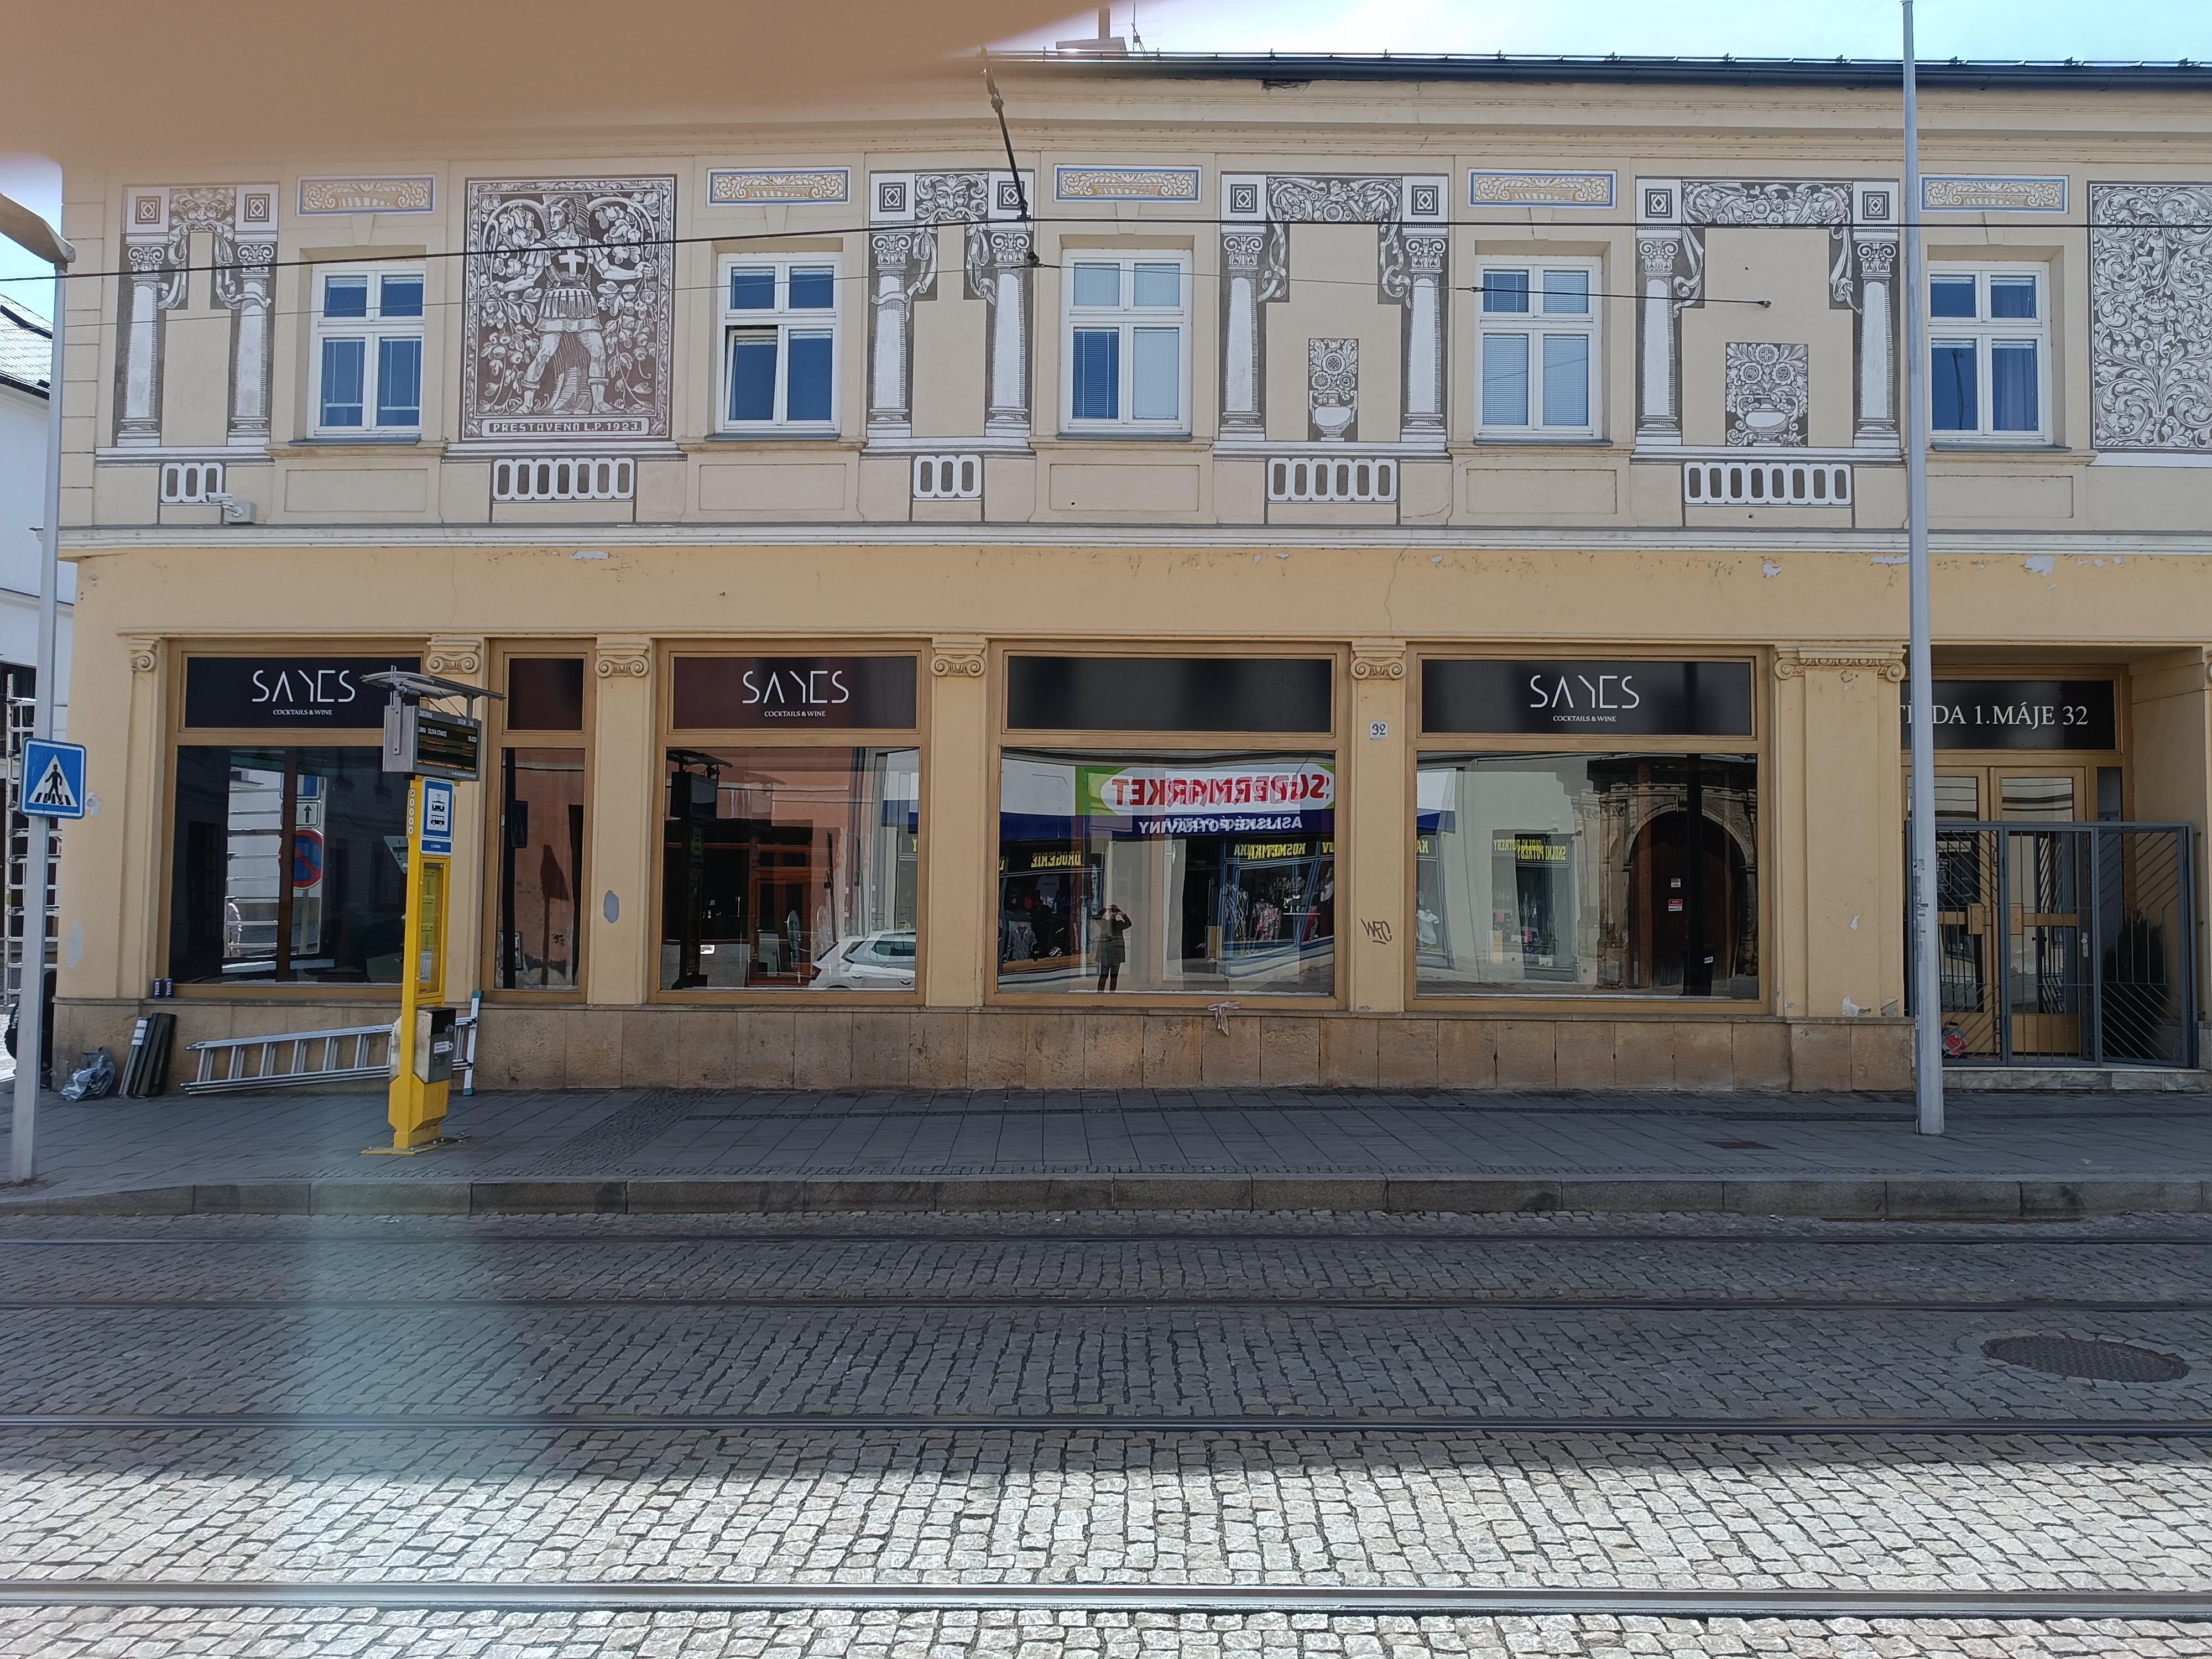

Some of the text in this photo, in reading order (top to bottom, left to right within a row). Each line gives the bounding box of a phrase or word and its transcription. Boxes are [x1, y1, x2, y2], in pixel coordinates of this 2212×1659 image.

[584, 422, 604, 431] L.P.
[606, 421, 640, 431] 1923.
[252, 670, 356, 702] SAYES
[742, 670, 849, 704] SAYES
[1530, 674, 1640, 709] SAYES
[1372, 723, 1386, 735] 32
[2062, 706, 2089, 726] 32
